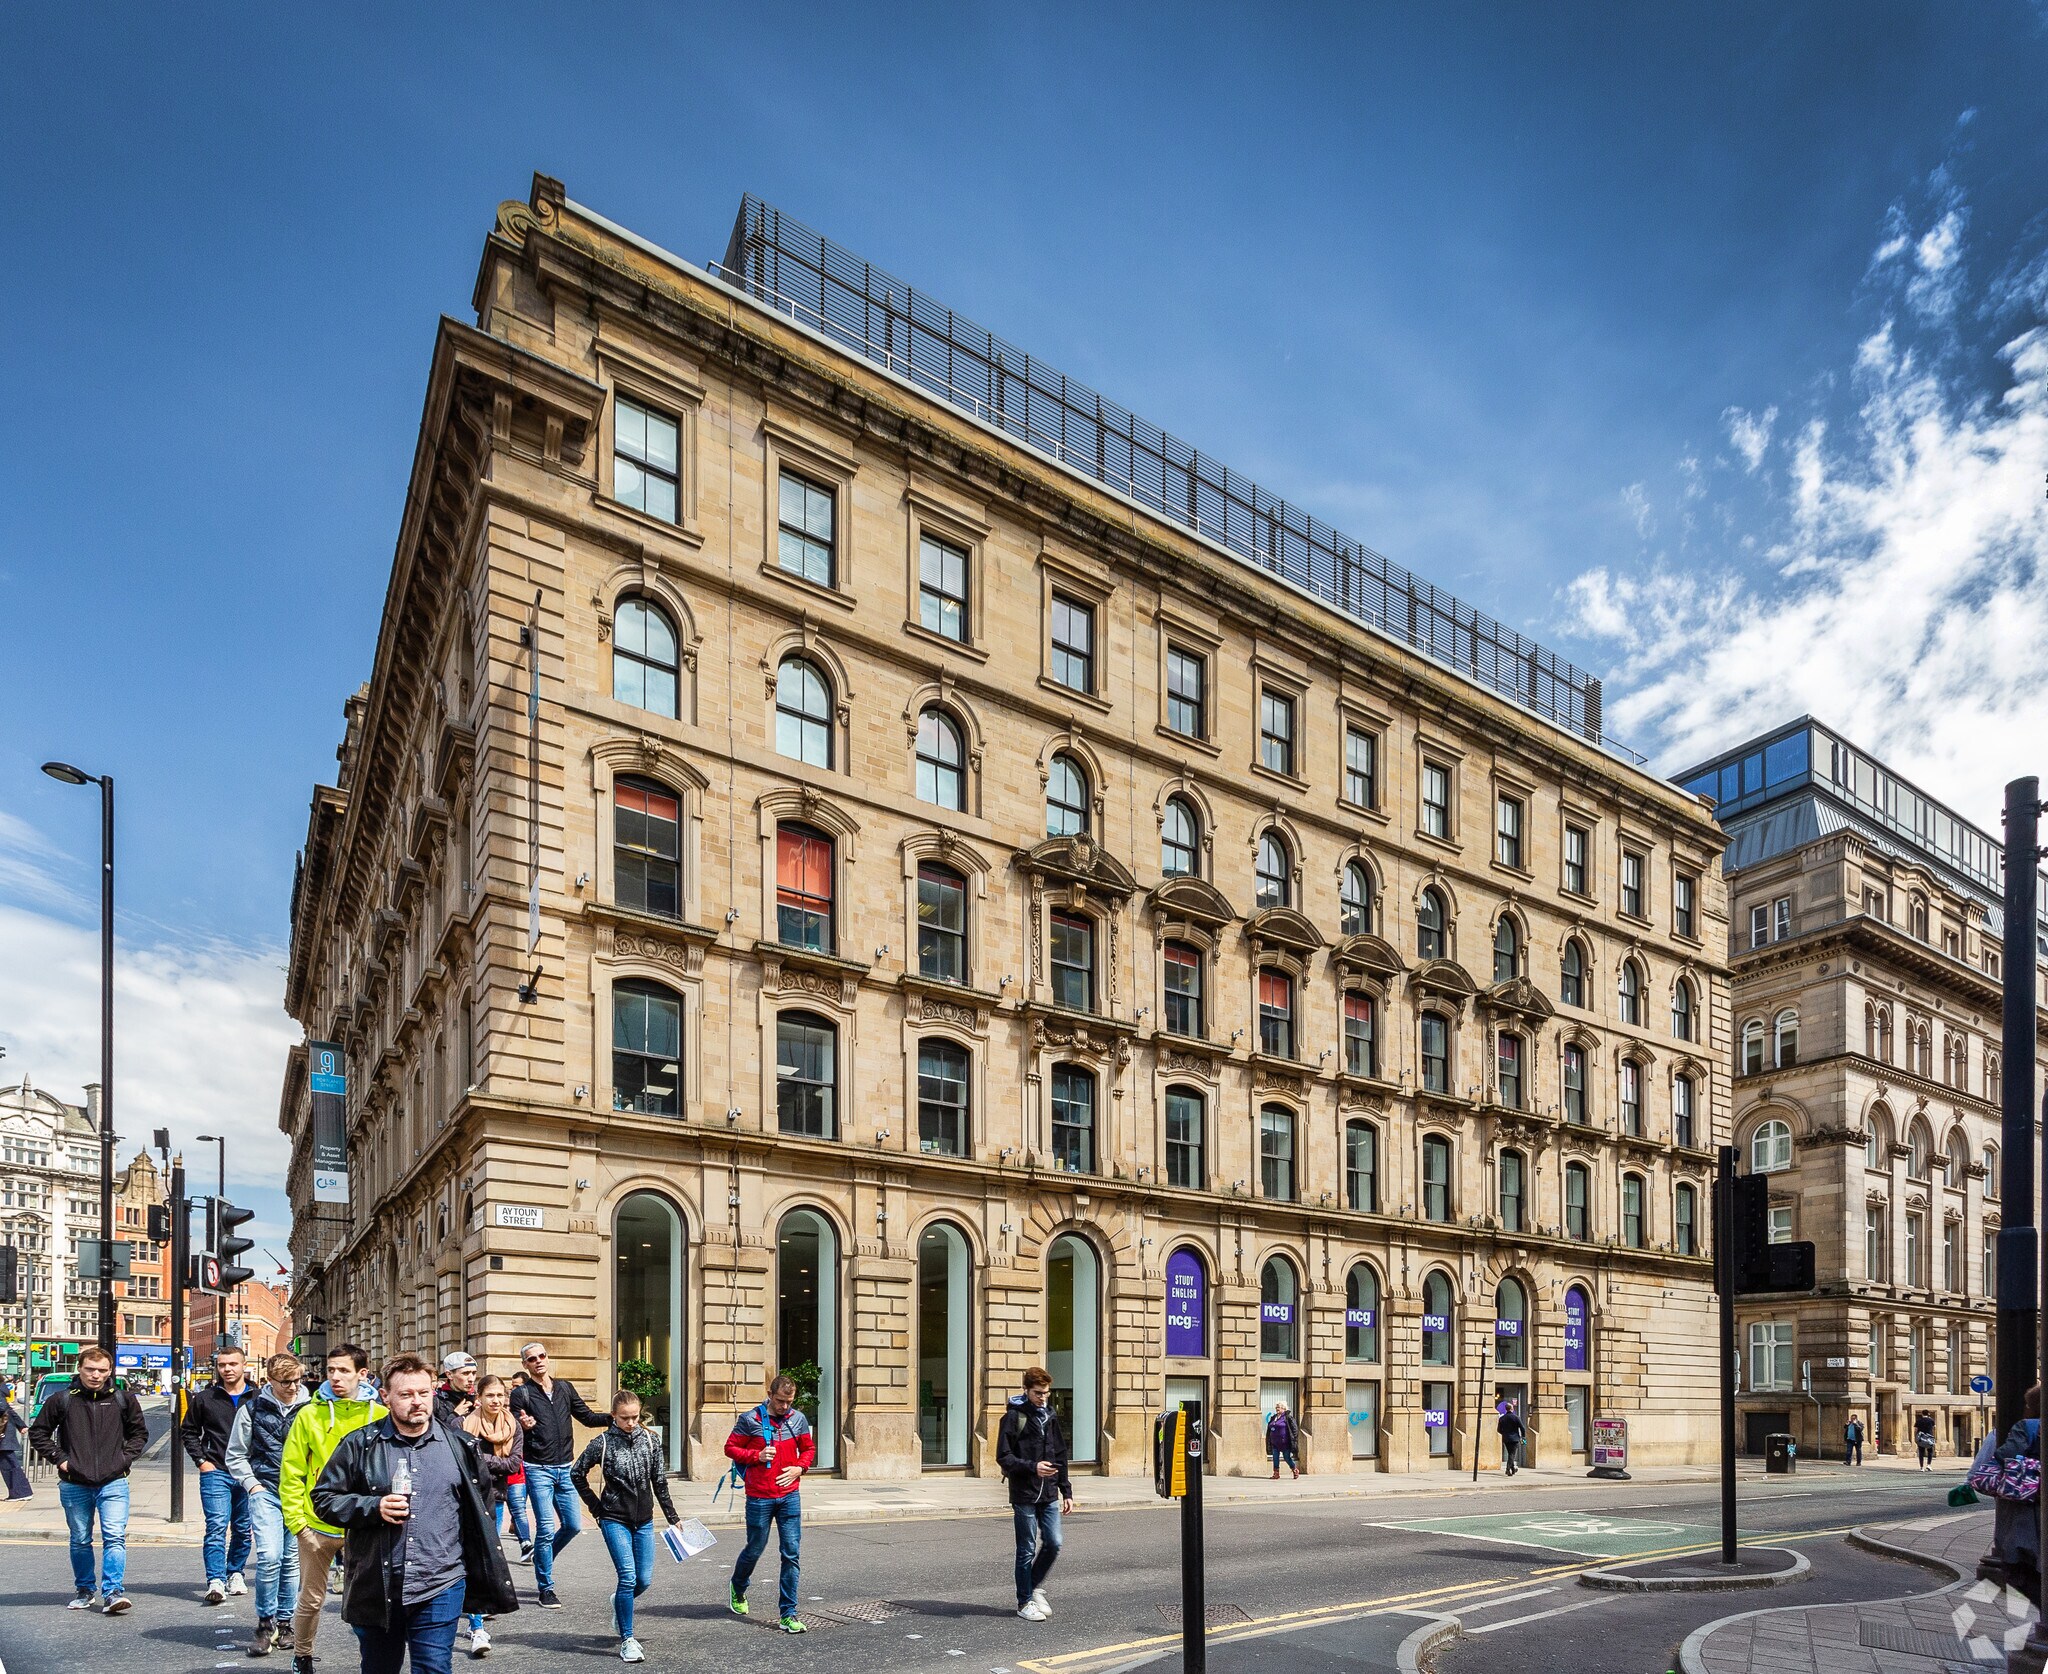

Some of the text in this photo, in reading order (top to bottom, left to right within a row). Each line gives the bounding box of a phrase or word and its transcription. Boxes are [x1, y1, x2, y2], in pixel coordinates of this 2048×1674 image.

[321, 1051, 334, 1075] 9
[320, 1144, 341, 1152] Property
[502, 1207, 538, 1217] AYTOUN
[503, 1216, 537, 1226] STREET
[1175, 1275, 1194, 1286] STUDY
[1172, 1287, 1197, 1299] ENGLISH
[1182, 1301, 1188, 1313] @
[1264, 1305, 1289, 1321] ncg
[1568, 1307, 1580, 1316] STUDY
[1168, 1315, 1192, 1329] ncg
[1348, 1310, 1371, 1326] ncg
[1424, 1315, 1445, 1330] ncg
[1499, 1320, 1517, 1334] ncg
[1565, 1338, 1579, 1350] ncg
[1425, 1411, 1445, 1425] ncg
